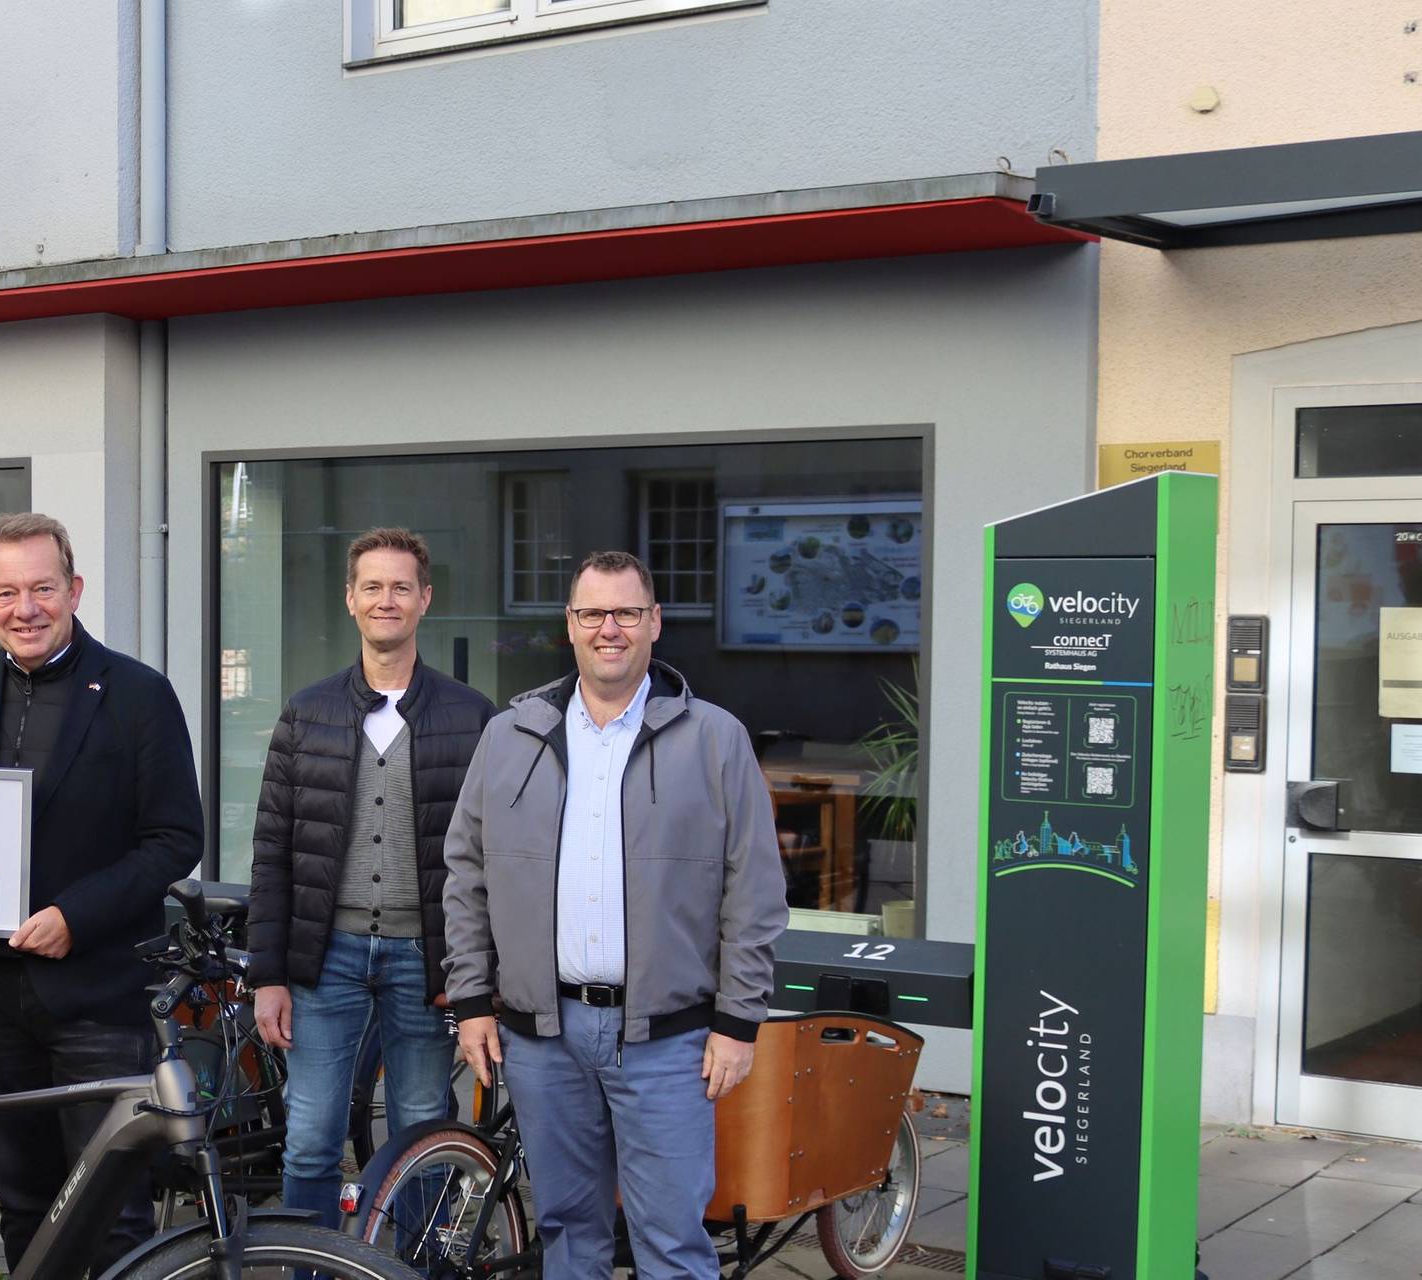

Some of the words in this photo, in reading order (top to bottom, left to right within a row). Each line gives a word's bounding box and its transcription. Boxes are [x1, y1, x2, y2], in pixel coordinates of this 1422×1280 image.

[1124, 448, 1193, 460] Chorverband
[1130, 462, 1187, 474] Siegerland
[1048, 590, 1140, 619] velocity
[1059, 617, 1122, 625] SIEGERLAND
[1053, 634, 1113, 647] connecT
[1044, 649, 1086, 657] SYSTEMHAUS
[1044, 662, 1072, 670] Rathaus
[1073, 663, 1097, 671] Siegen
[843, 942, 896, 960] 12
[1022, 989, 1080, 1183] velocity
[1075, 1032, 1092, 1165] SIEGERLAND
[50, 1160, 87, 1224] CUBE
